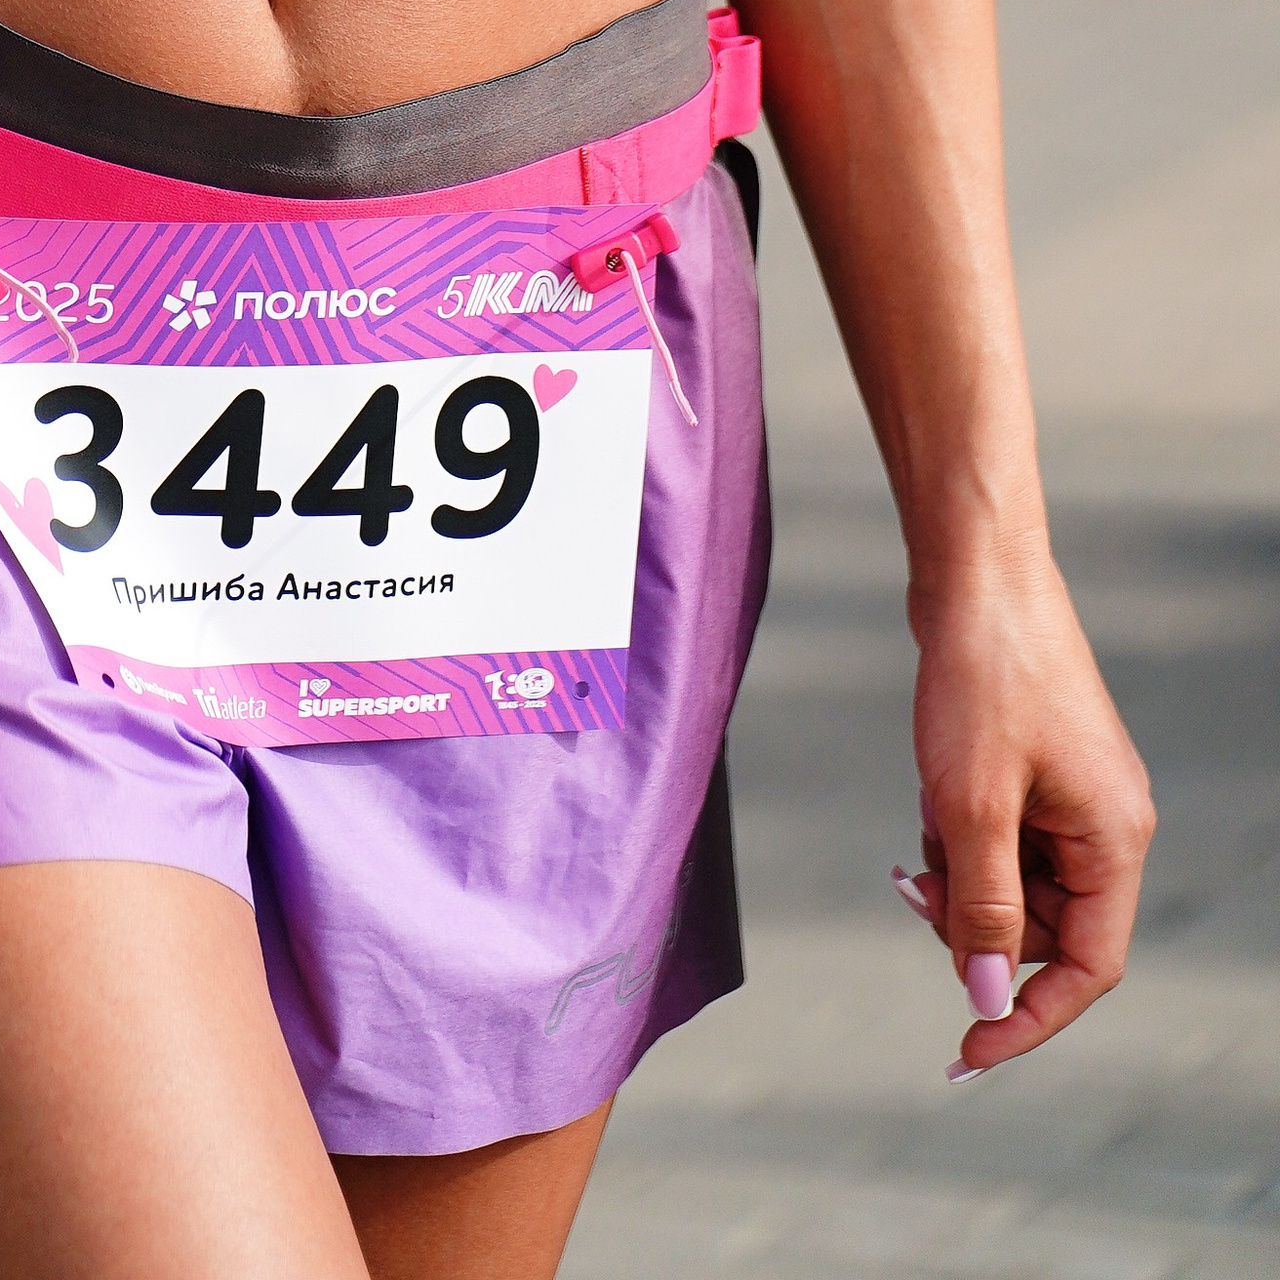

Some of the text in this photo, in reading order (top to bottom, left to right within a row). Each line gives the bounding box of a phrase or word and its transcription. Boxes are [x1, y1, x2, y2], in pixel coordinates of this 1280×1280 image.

[233, 286, 397, 320] ПОЛЮС
[34, 375, 540, 553] 3449
[112, 573, 454, 613] Пришиба Анастасия
[192, 686, 267, 720] Triatleta
[298, 693, 451, 718] SUPERSPORT
